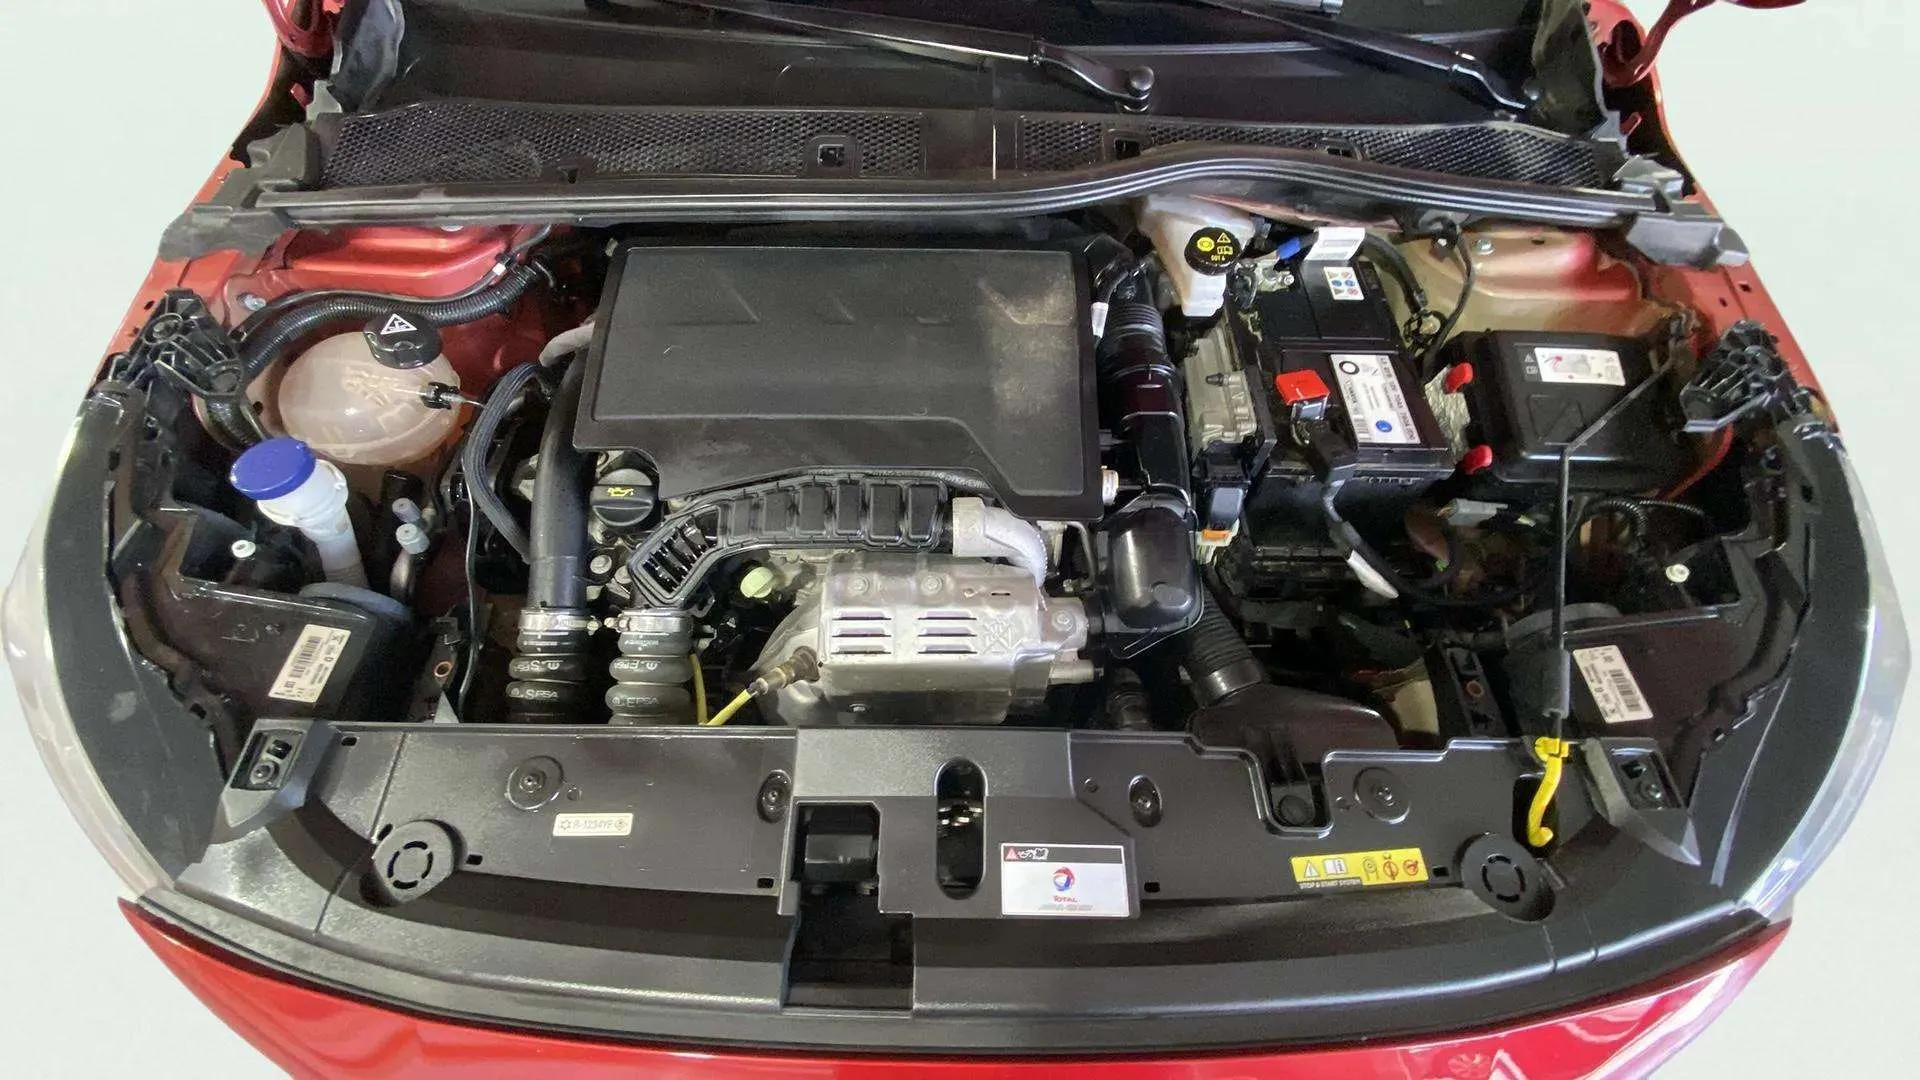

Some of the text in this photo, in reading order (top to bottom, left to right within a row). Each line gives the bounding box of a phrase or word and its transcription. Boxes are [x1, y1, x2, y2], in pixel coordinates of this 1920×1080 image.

[1299, 882, 1315, 890] STOP
[1320, 880, 1338, 888] START
[1338, 878, 1361, 887] SYSTEM
[1053, 895, 1078, 903] TOTAL
